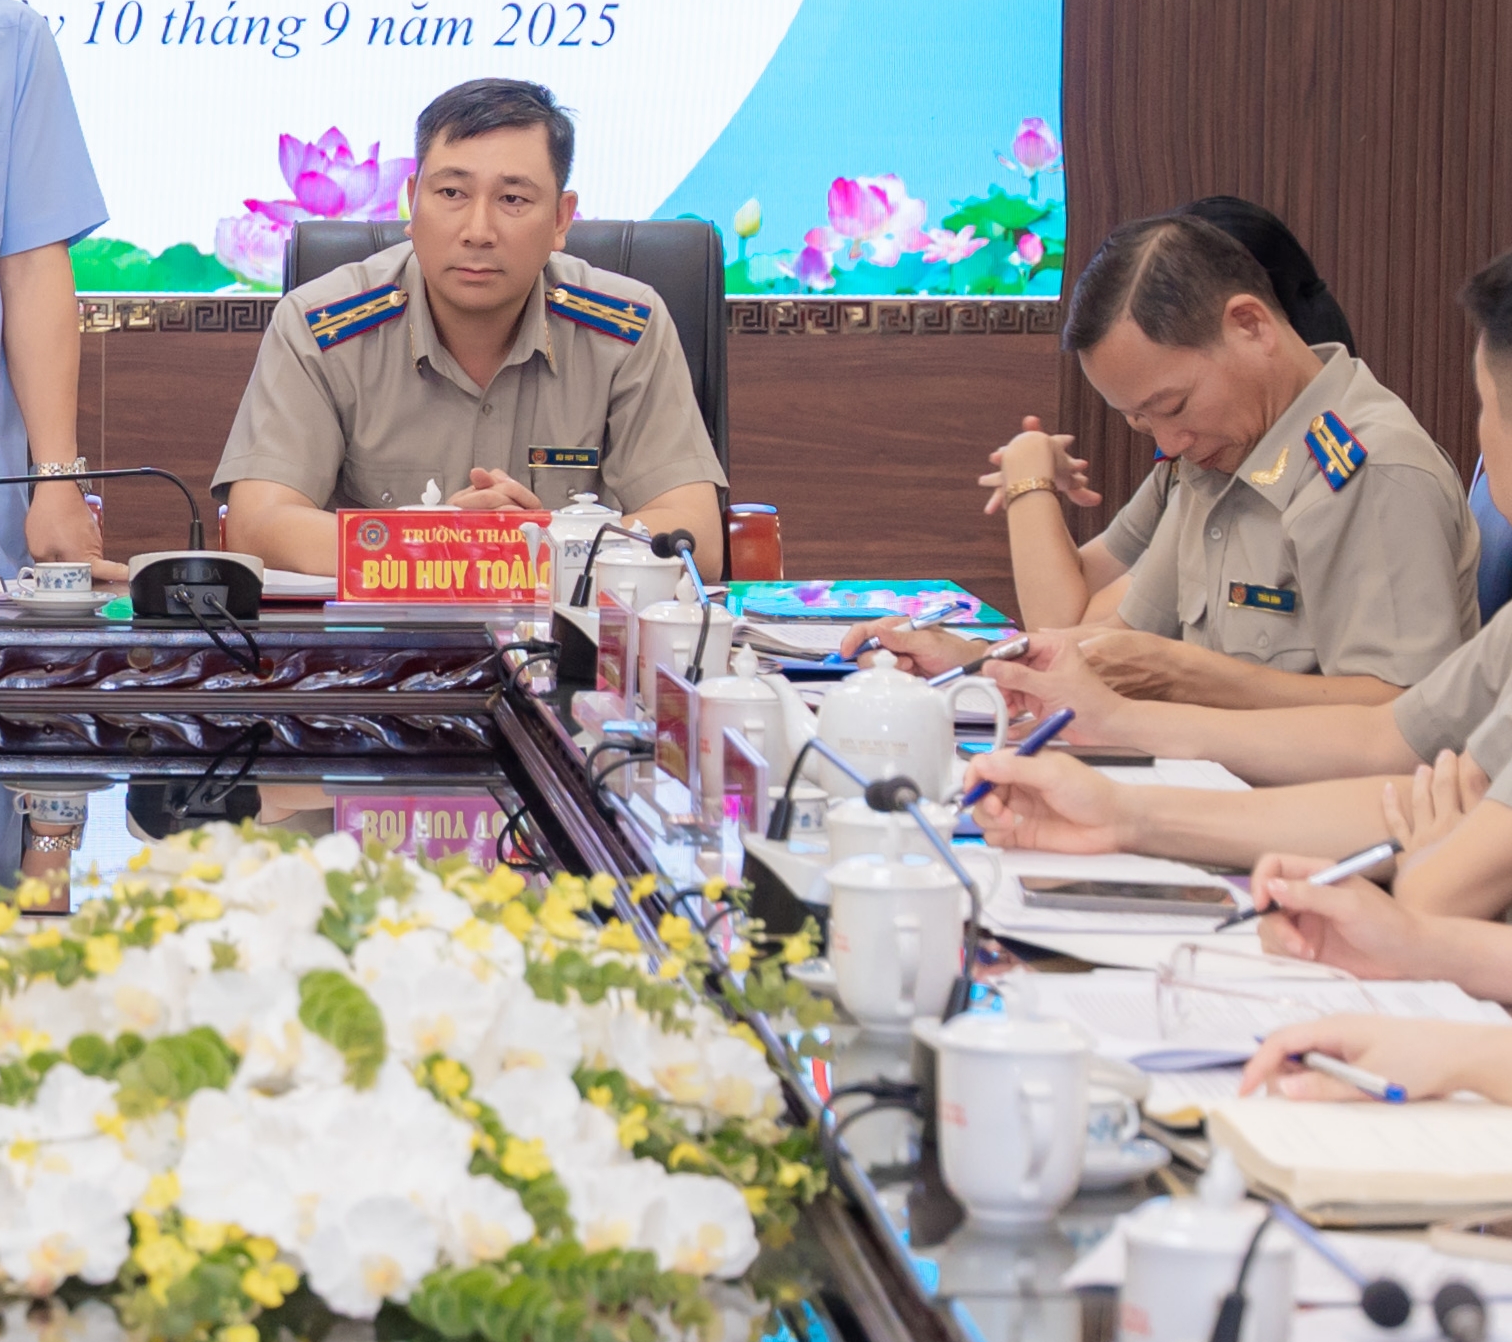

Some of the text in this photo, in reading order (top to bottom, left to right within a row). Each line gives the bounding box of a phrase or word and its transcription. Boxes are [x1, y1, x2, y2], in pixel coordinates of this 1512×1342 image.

[85, 1, 144, 45] 10
[161, 0, 304, 59] tháng
[323, 3, 350, 46] 9
[368, 4, 474, 46] năm
[493, 2, 621, 47] 2025
[402, 525, 472, 544] TRƯỞNG
[362, 554, 408, 590] BÙI
[416, 559, 469, 589] HUY
